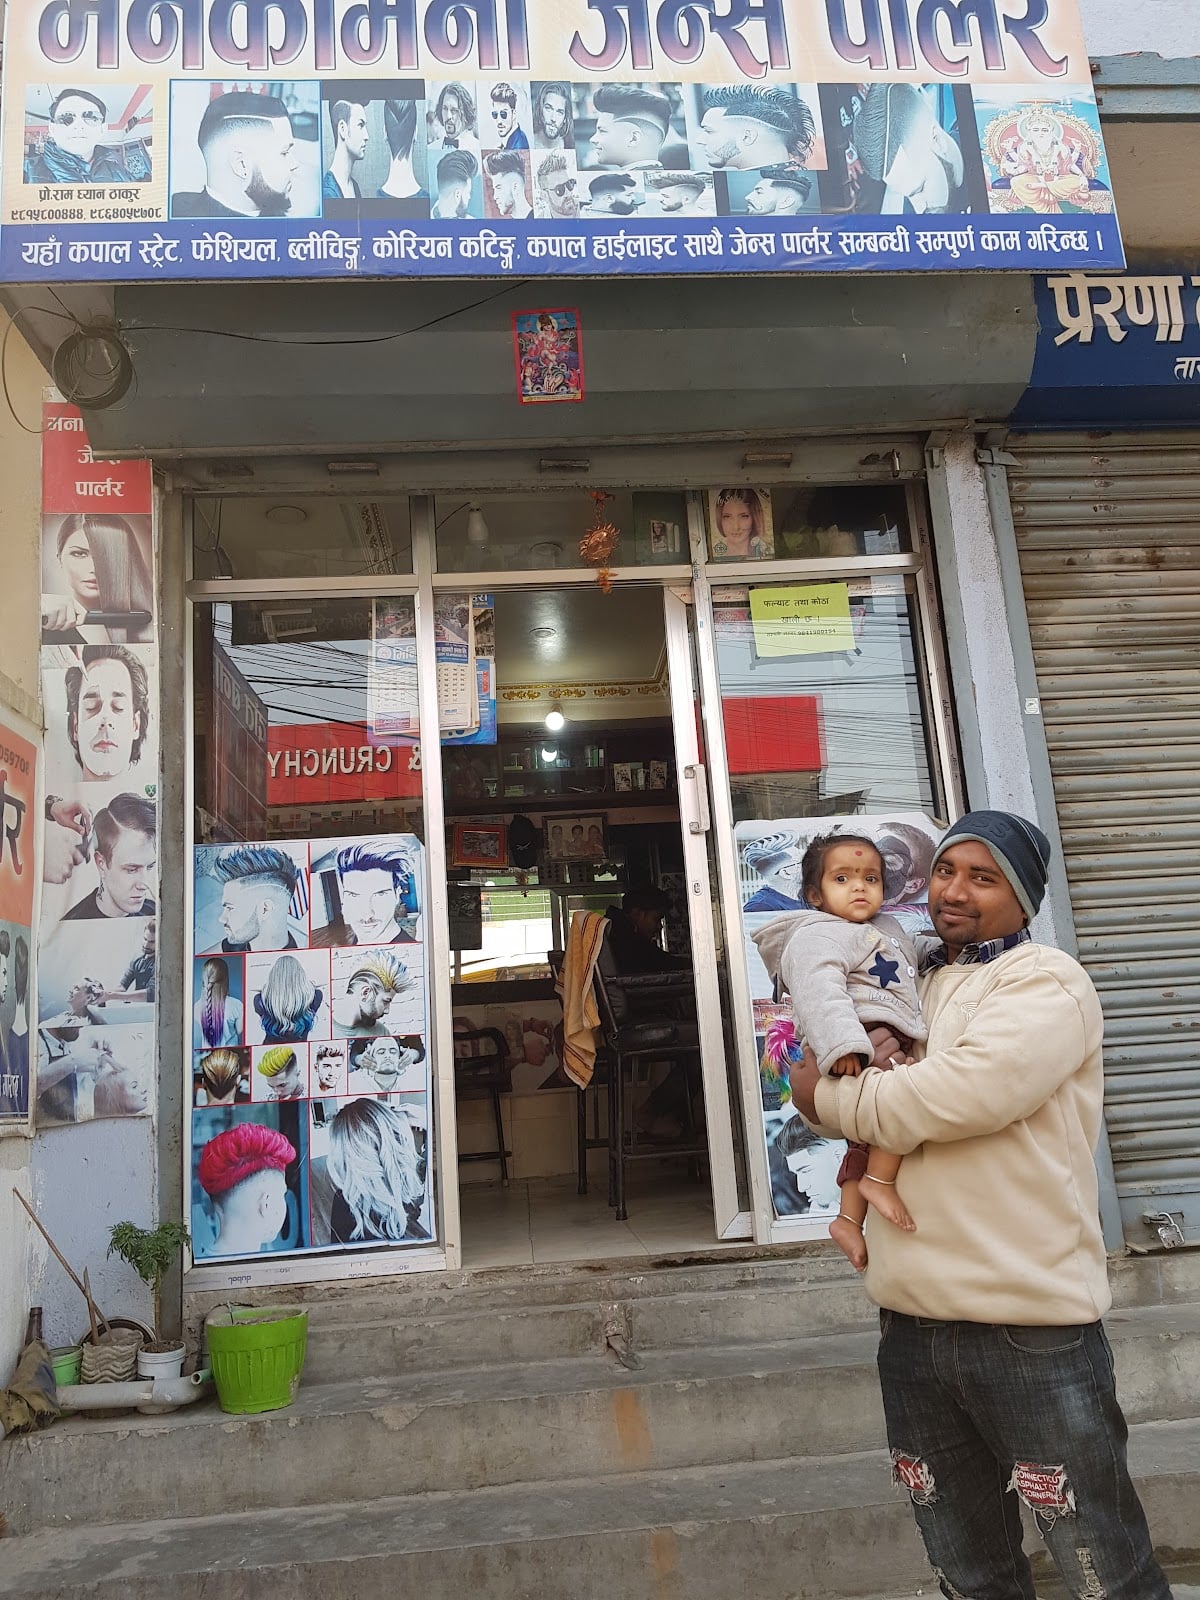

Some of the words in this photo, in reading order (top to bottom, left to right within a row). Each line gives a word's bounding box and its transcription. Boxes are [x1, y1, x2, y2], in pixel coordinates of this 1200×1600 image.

[109, 188, 141, 202] ठाकुर
[21, 235, 62, 267] यहाँ
[68, 240, 132, 264] कपाल
[191, 232, 281, 263] फेशियल,
[372, 229, 453, 260] कोरियन
[527, 236, 586, 259] कपाल
[592, 229, 678, 261] हाईलाइट
[683, 226, 723, 258] साथै
[729, 226, 776, 256] जेन्स
[781, 226, 833, 255] पार्लर
[837, 225, 910, 255] सम्बन्धी
[980, 230, 1021, 252] काम
[1026, 224, 1090, 253] गरिन्छ
[75, 478, 125, 497] पार्लर
